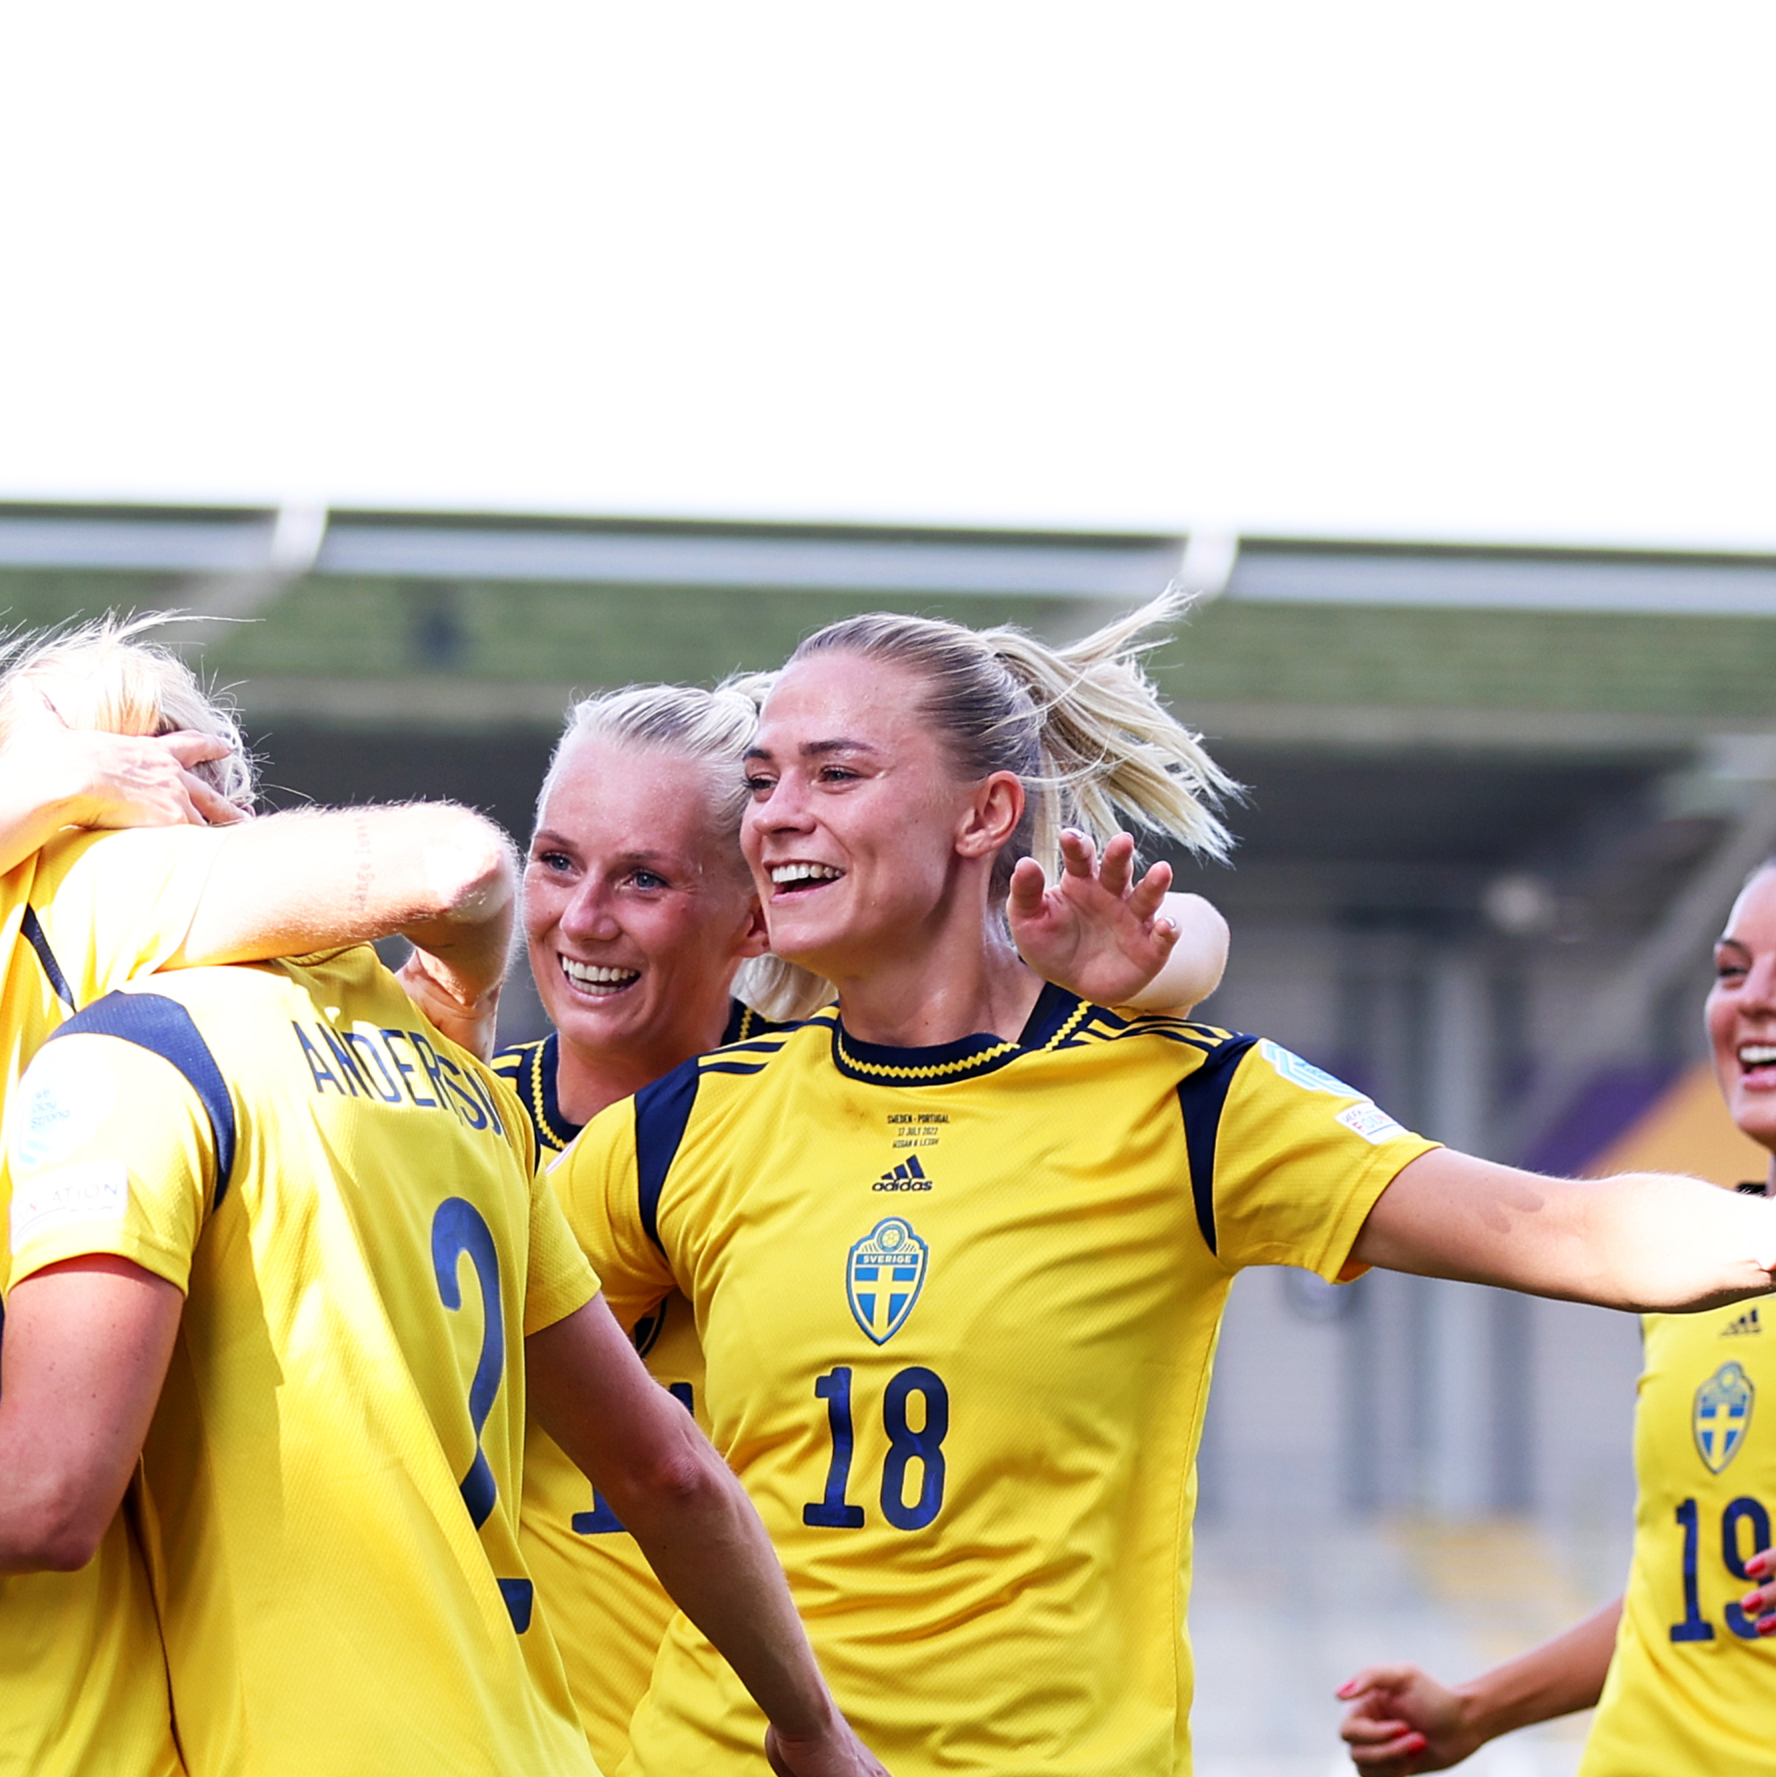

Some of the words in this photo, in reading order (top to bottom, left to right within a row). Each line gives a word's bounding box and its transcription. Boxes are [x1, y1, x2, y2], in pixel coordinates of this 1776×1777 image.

[872, 1178, 933, 1192] adidas
[863, 1255, 912, 1264] SVERIGE
[803, 1366, 949, 1532] 18
